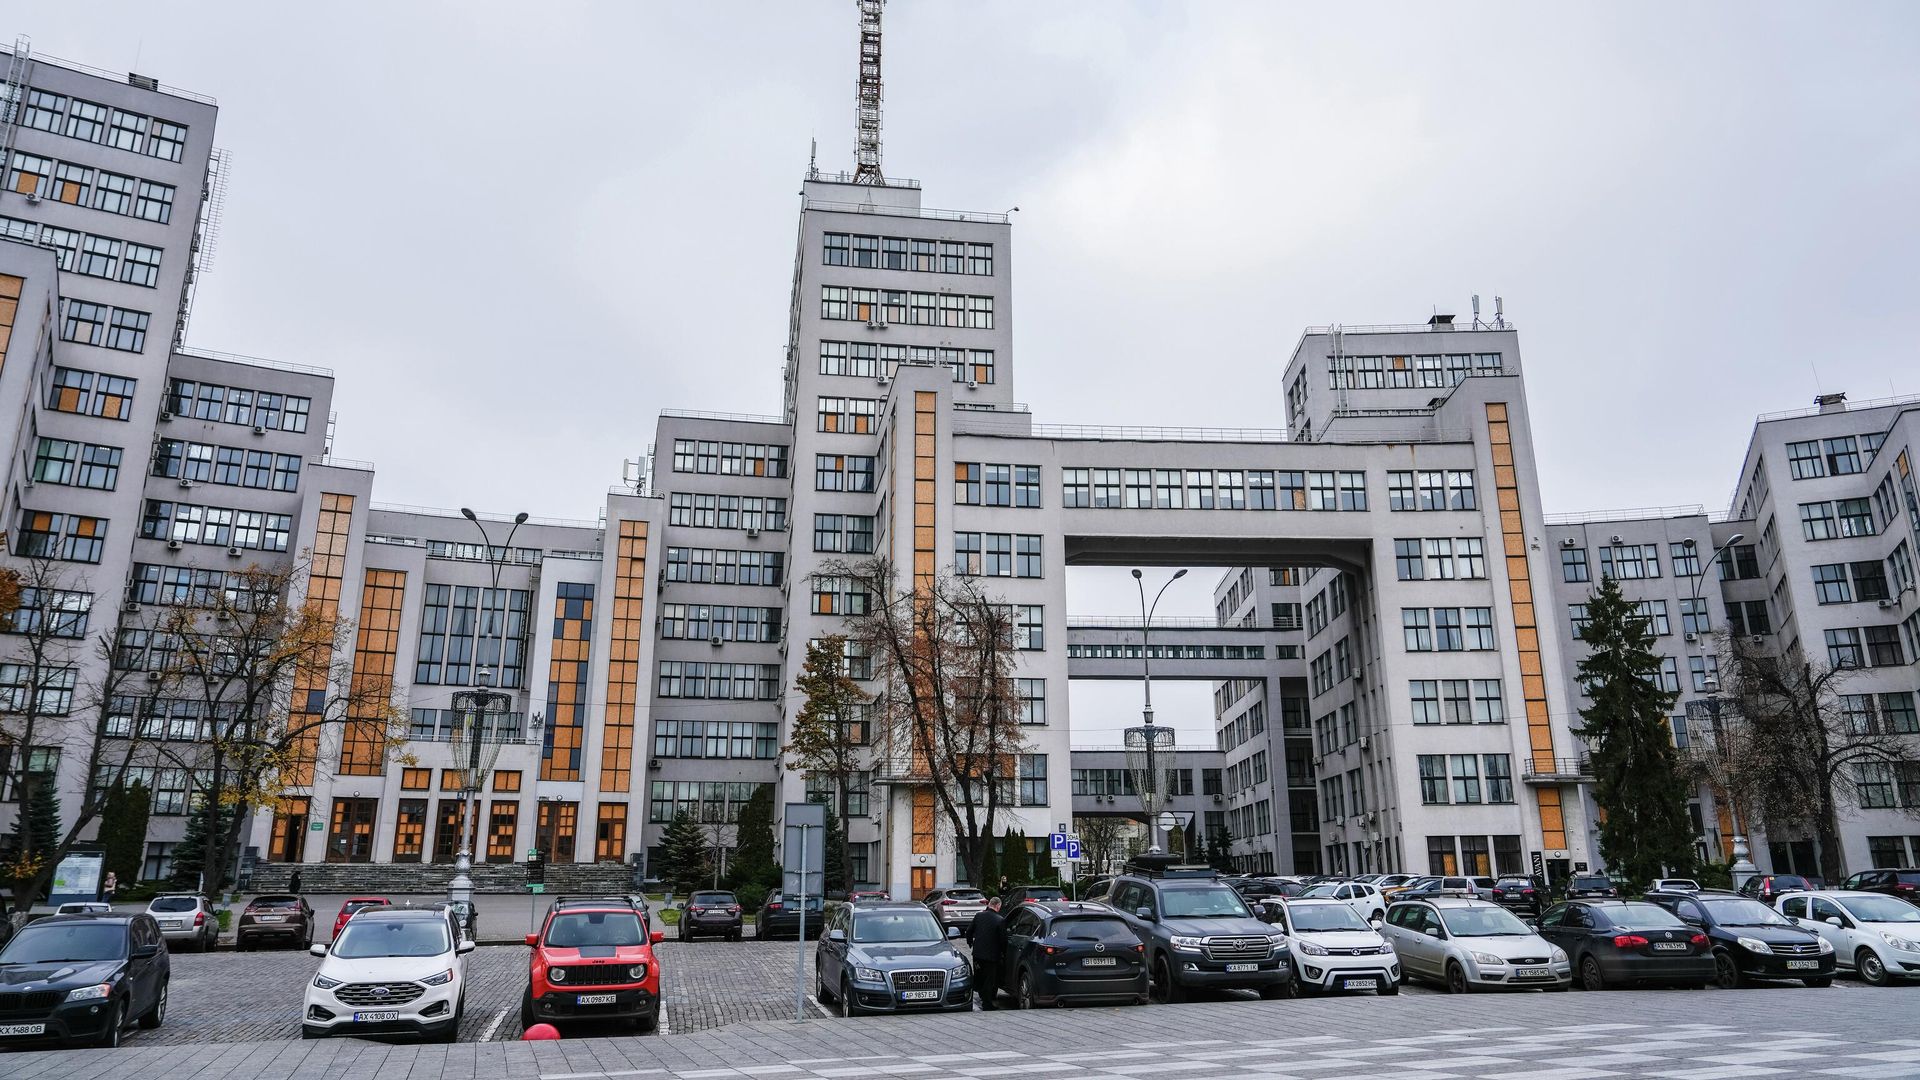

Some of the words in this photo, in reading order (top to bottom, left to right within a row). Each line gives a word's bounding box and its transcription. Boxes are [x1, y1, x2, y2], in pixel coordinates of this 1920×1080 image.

[1054, 835, 1064, 849] P
[1069, 842, 1078, 856] P
[1533, 854, 1544, 880] AVANI
[581, 996, 591, 1004] AX
[359, 1013, 369, 1021] AX
[369, 1012, 385, 1020] 4108
[386, 1012, 397, 1020] OX
[12, 1026, 30, 1034] 1488
